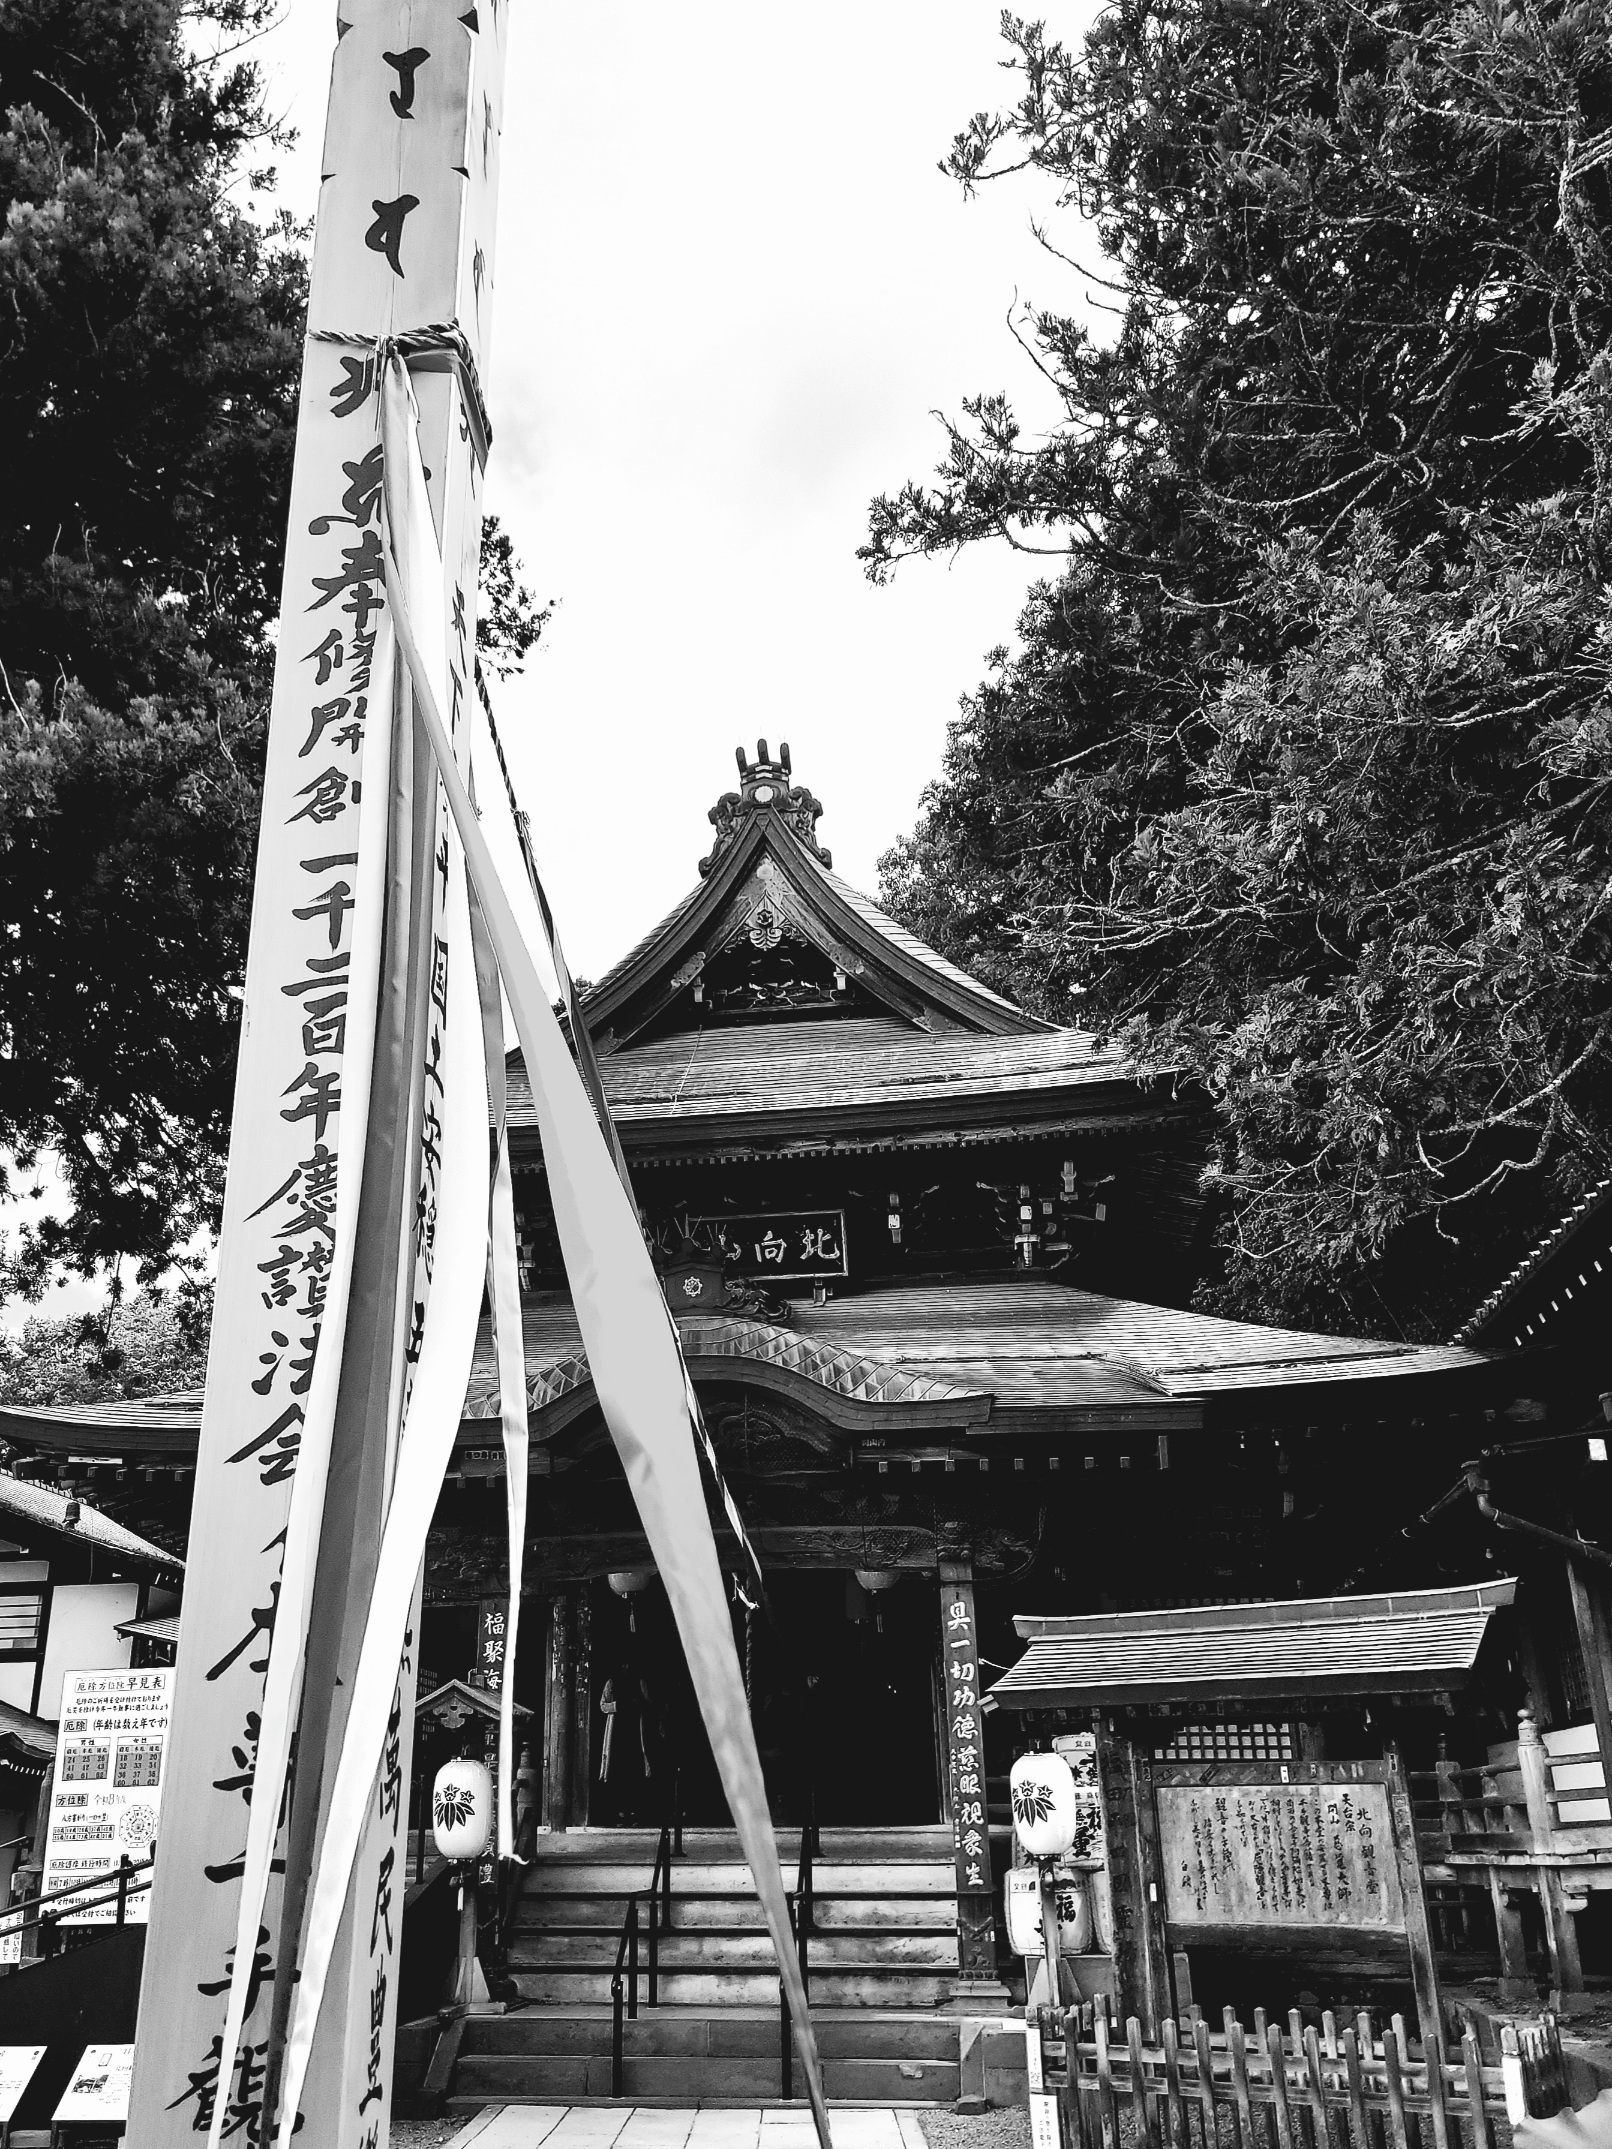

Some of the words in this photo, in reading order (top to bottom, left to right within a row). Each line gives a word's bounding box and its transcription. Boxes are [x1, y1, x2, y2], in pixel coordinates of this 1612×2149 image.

[65, 1720, 87, 1732] 厄除
[134, 1753, 143, 1761] 19
[149, 1753, 158, 1761] 20
[133, 1770, 141, 1778] 37
[57, 1795, 87, 1806] 方位除
[1342, 1793, 1356, 1833] 天台宗
